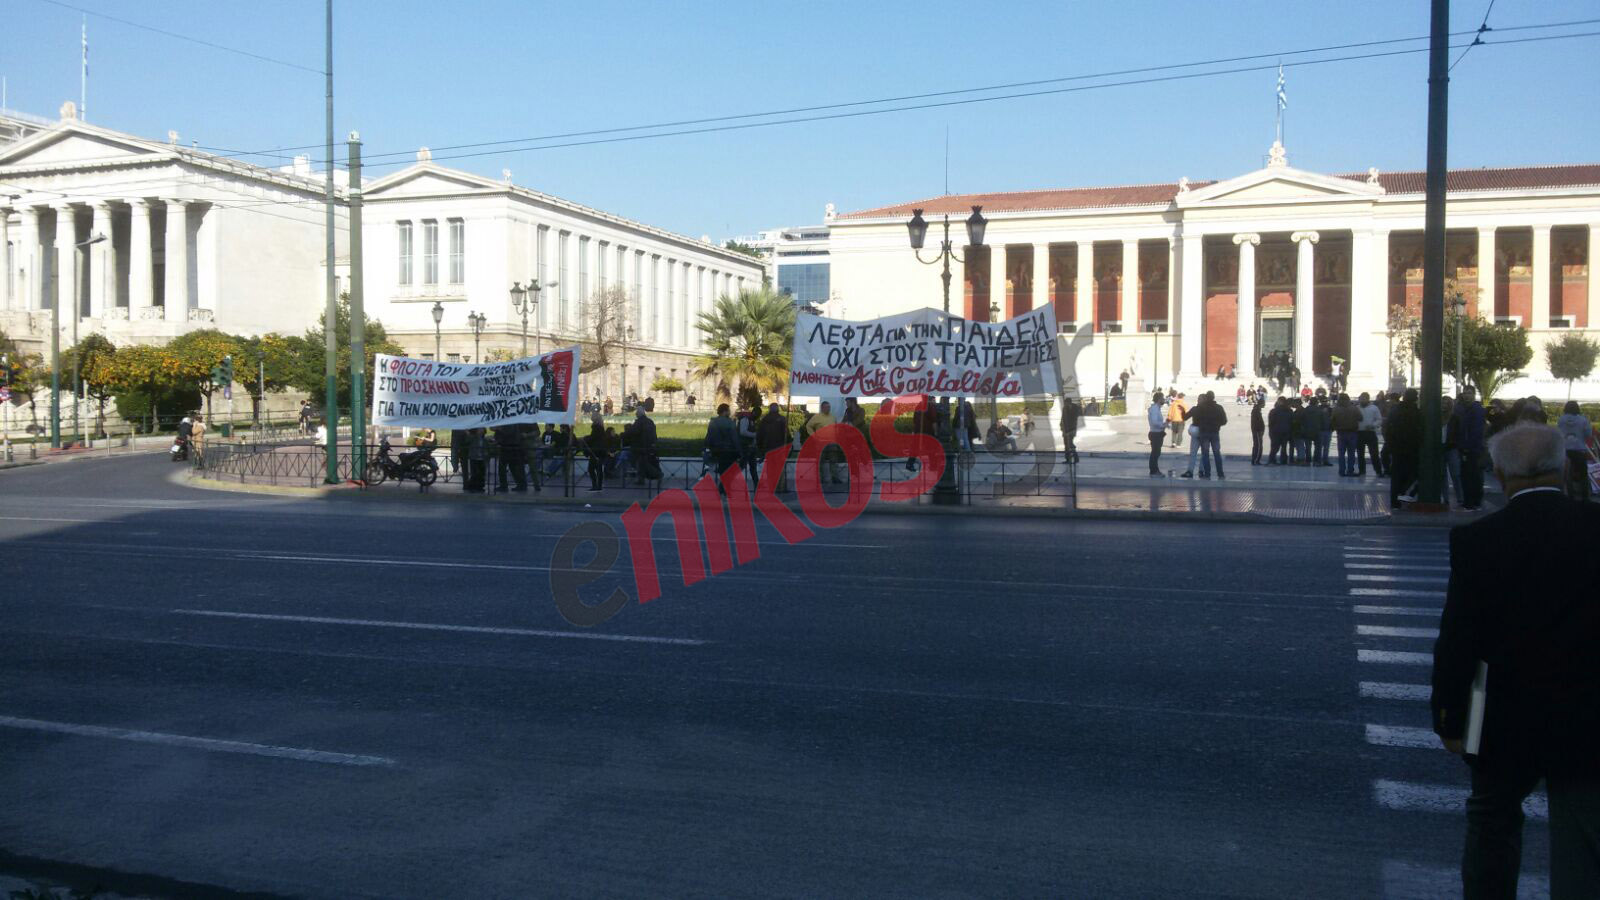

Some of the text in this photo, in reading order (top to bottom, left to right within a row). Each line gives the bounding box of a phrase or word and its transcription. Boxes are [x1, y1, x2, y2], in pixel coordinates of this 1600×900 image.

[809, 312, 1049, 346] ΛΕΦΤΑ ΓΙΑ ΤΗΝ ΠΑΙΔΕΙΑ
[827, 339, 1057, 369] ΟΧΙ ΣΤΟΥΣ ΤΡΑΠΕΖΙΤΕΣ
[390, 360, 432, 376] ΦΛΟΓΑ
[434, 364, 462, 377] ΤΟΥ
[379, 377, 470, 394] ΣΤΟ ΠΡΟΣΚΗΝΙΟ
[484, 375, 516, 387] ΑΜΕΣΗ
[792, 371, 841, 385] ΜΑΘΗΤΕΣ
[478, 384, 533, 397] ΔΗΜΟΚΡΑΤΙΑ
[379, 401, 394, 416] ΓΙΑ
[400, 402, 420, 416] ΤΗΝ
